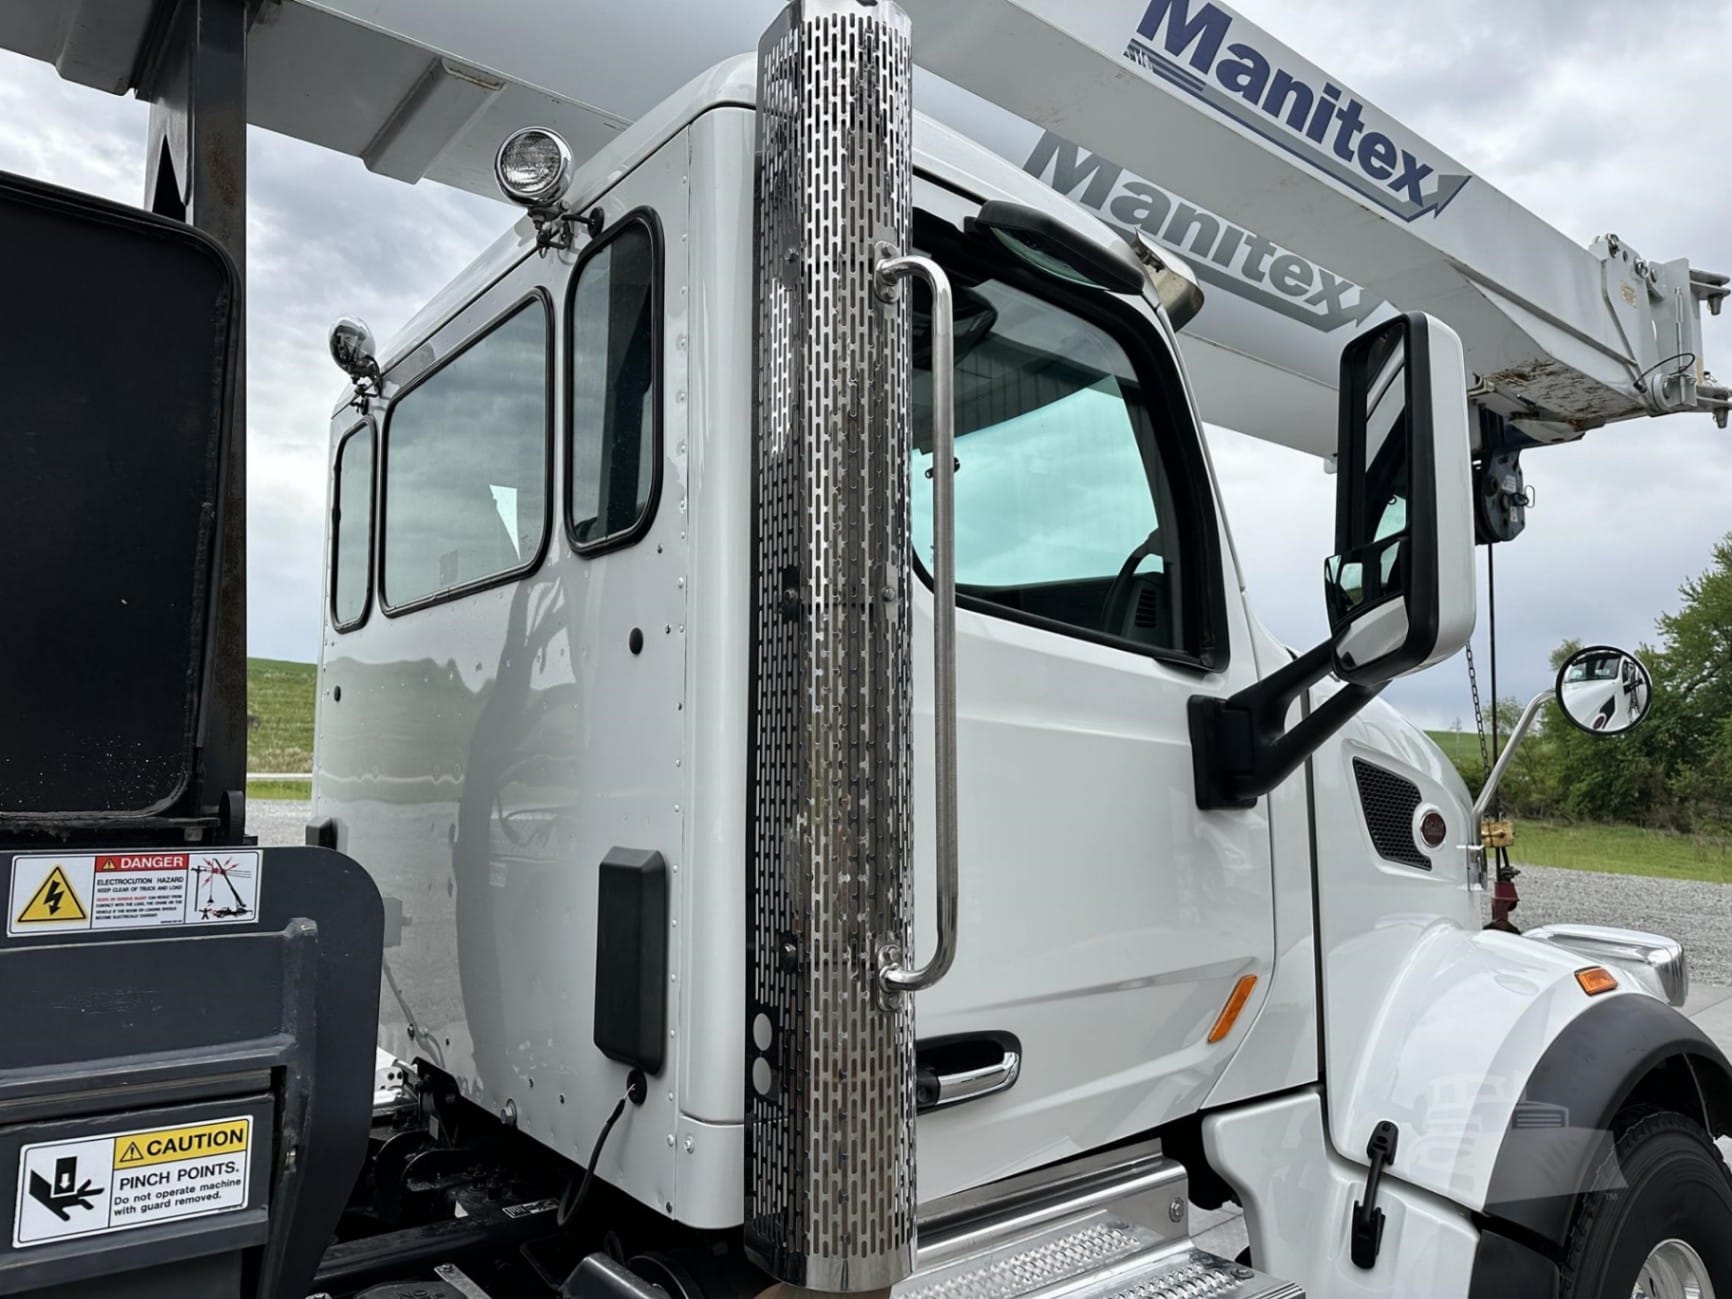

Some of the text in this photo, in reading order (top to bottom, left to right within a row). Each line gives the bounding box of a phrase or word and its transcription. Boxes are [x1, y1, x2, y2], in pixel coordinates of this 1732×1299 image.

[1136, 0, 1435, 207] Manitex
[1022, 129, 1357, 317] Manitex
[121, 856, 183, 869] DANGER
[96, 876, 184, 886] ELECTROCUTION HAZARD
[146, 1128, 244, 1156] CAUTION
[119, 1161, 240, 1191] PINCH POINTS.
[113, 1190, 222, 1217] with guard removed.
[114, 1178, 242, 1206] Do not operate machine
